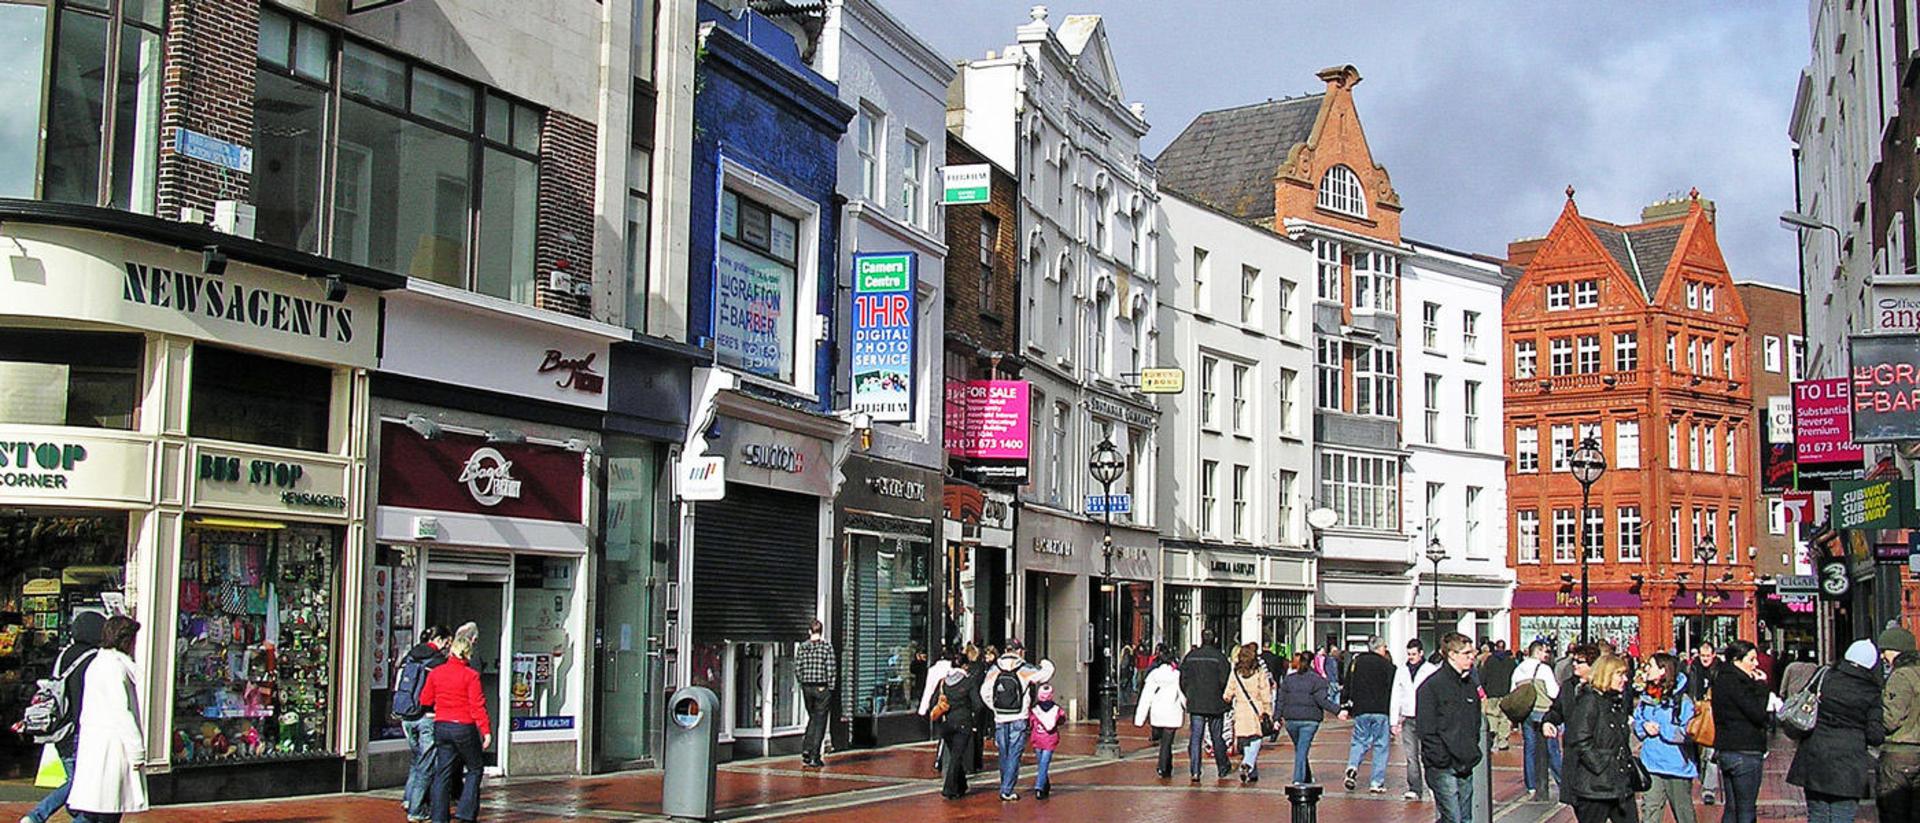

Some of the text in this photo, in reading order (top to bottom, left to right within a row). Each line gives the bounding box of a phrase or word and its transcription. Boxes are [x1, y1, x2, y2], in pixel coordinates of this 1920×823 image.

[862, 261, 904, 274] Camera
[865, 275, 900, 288] Centre
[124, 261, 353, 344] NEWSAGENTS
[855, 295, 910, 329] 1HR
[856, 329, 909, 341] DIGITAL
[856, 341, 909, 354] PHOTO
[538, 349, 599, 388] Bagel
[855, 354, 908, 367] SERVICE
[1874, 363, 1920, 386] GR
[989, 387, 1017, 399] SALE
[1798, 382, 1847, 400] TO LE
[1797, 417, 1834, 427] Reverse
[1797, 426, 1840, 437] Premium
[978, 439, 997, 449] 673
[1000, 439, 1024, 449] 1400
[1799, 443, 1811, 453] 01
[1814, 441, 1833, 452] 673
[200, 454, 303, 489] BUS STOP
[458, 460, 515, 495] Bagel
[281, 490, 347, 510] NEWSAGENTS
[1841, 481, 1891, 505] SUBWAY
[1841, 492, 1891, 516] SUBWAY
[1841, 504, 1892, 528] SUBWAY
[1823, 563, 1849, 594] 3
